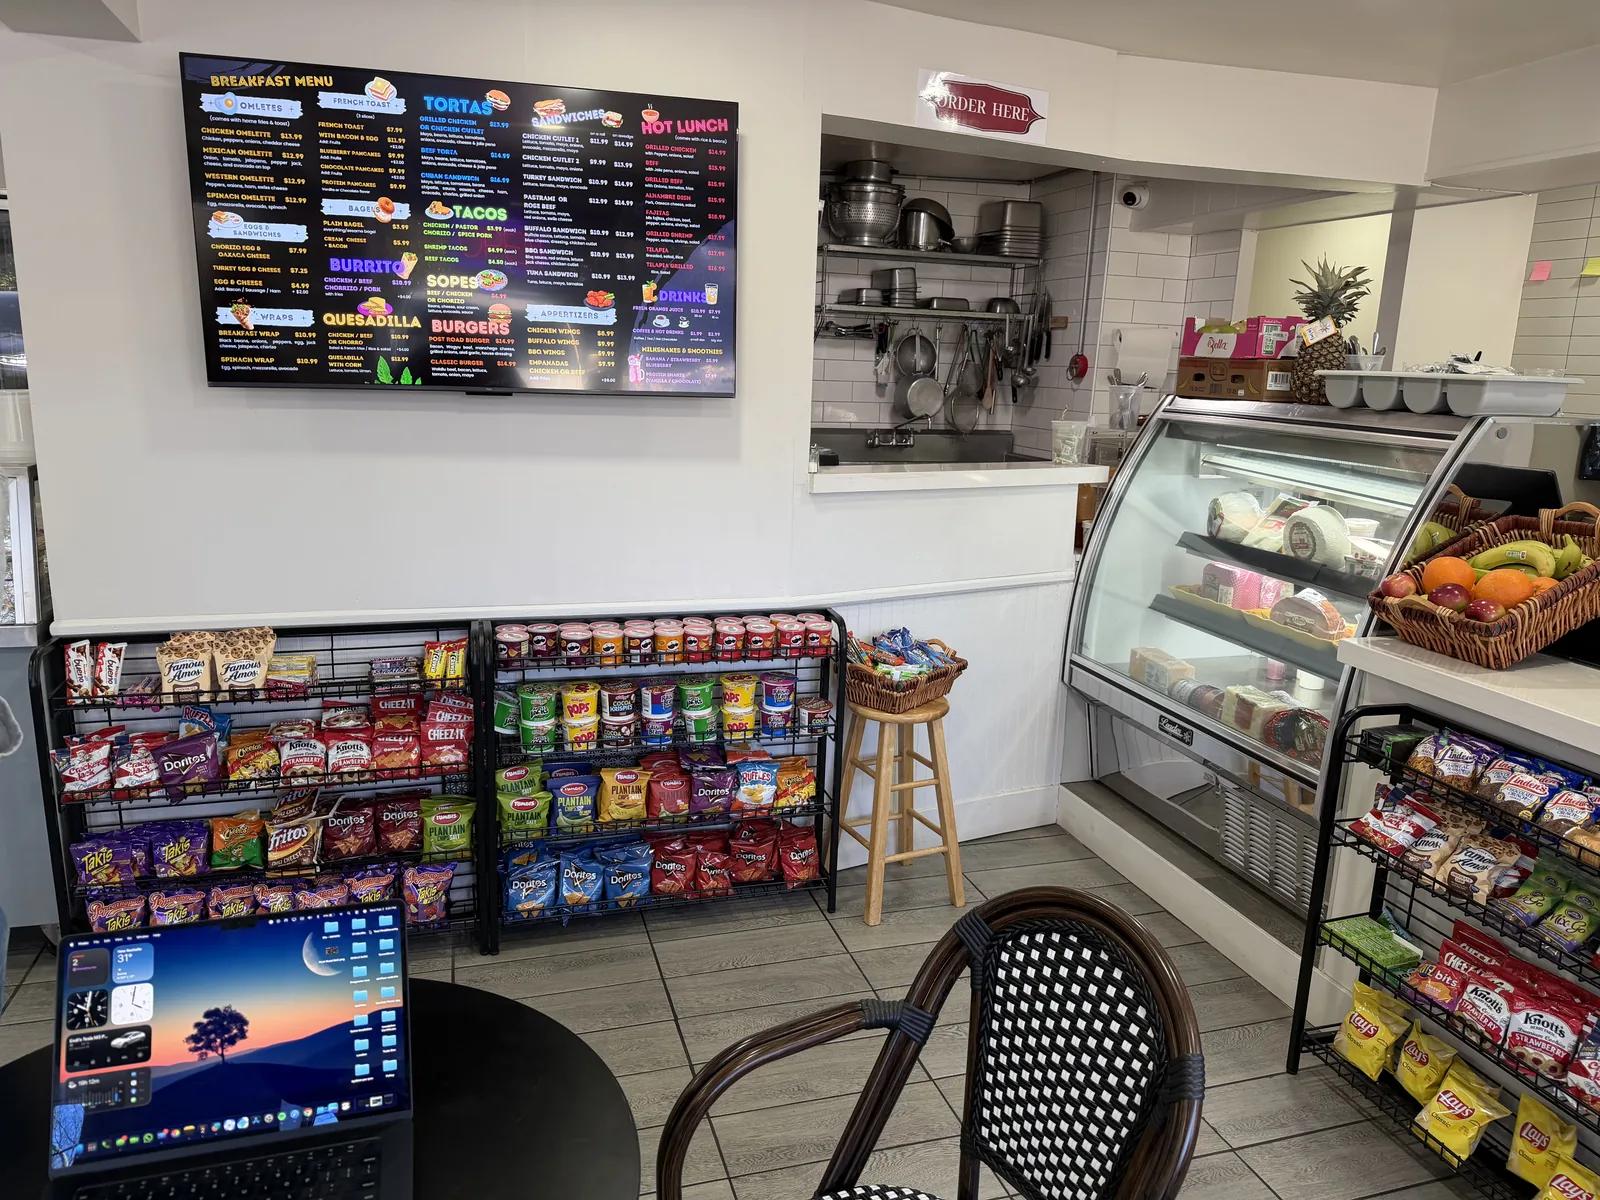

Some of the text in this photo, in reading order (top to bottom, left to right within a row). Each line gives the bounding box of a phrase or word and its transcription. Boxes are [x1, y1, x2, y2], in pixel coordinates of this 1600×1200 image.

[210, 76, 333, 88] BREAKFAST MENU
[240, 101, 282, 112] OMLETES
[333, 98, 364, 106] FRENCH
[424, 96, 493, 115] TORTAS
[938, 94, 1030, 122] ORDER HERE
[532, 108, 605, 127] SANDWICHES
[201, 127, 302, 140] CHICKEN OMELETTE $13.99
[642, 119, 728, 135] HOT LUNCH
[202, 147, 237, 155] MEXICAN
[238, 149, 273, 158] OMELETTE
[205, 172, 238, 181] WESTERN
[240, 175, 274, 183] OMELETTE
[206, 192, 239, 200] SPINACH
[453, 205, 507, 221] TACOS
[233, 230, 281, 238] SANDWICHES
[330, 257, 405, 274] BURRITO
[426, 274, 479, 289] SOPES
[260, 313, 293, 321] WRAPS
[323, 313, 422, 328] QUESADILLA
[432, 319, 510, 335] BURGERS
[74, 659, 84, 682] bueno
[108, 660, 116, 684] bueno
[164, 660, 205, 676] Famous
[169, 668, 202, 682] Amos
[220, 661, 262, 676] Famous
[224, 670, 259, 682] Amos
[567, 703, 590, 717] POPS
[184, 706, 217, 730] RUFFLES
[289, 741, 317, 751] Knott's
[336, 742, 364, 752] Knott's
[164, 752, 207, 770] Doritos
[501, 778, 536, 792] PLANTAIN
[742, 772, 771, 783] RUFFLES
[611, 785, 642, 794] PLANTAIN
[698, 788, 730, 797] Doritos
[558, 796, 591, 806] PLANTAIN
[328, 816, 365, 827] Doritos
[383, 810, 418, 822] Doritos
[507, 812, 542, 821] PLANTAIN
[269, 824, 308, 851] Fritos
[429, 824, 465, 837] PLANTAIN
[164, 838, 190, 862] Takis
[82, 846, 113, 872] Takis
[655, 861, 686, 872] Doritos
[564, 869, 597, 880] Doritos
[611, 872, 642, 884] Doritos
[512, 878, 547, 889] Doritos
[361, 890, 381, 903] Takis
[417, 885, 437, 901] Takis
[164, 906, 188, 924] Takis
[222, 900, 245, 918] Takis
[106, 914, 130, 932] Takis
[118, 954, 133, 963] 31°
[1435, 970, 1458, 987] bits
[1470, 986, 1503, 1014] Knott's
[1461, 1000, 1498, 1030] STRAWBERRY
[1350, 1012, 1378, 1034] Lay's
[1524, 1012, 1566, 1038] Knott's
[1405, 1042, 1428, 1062] Lay's
[1516, 1034, 1567, 1058] STRAWBERRY
[1402, 1062, 1418, 1077] Classic
[1438, 1091, 1474, 1116] Lay's
[1431, 1112, 1450, 1128] Classic
[1521, 1124, 1549, 1147] Lay's
[1519, 1150, 1536, 1166] Classic
